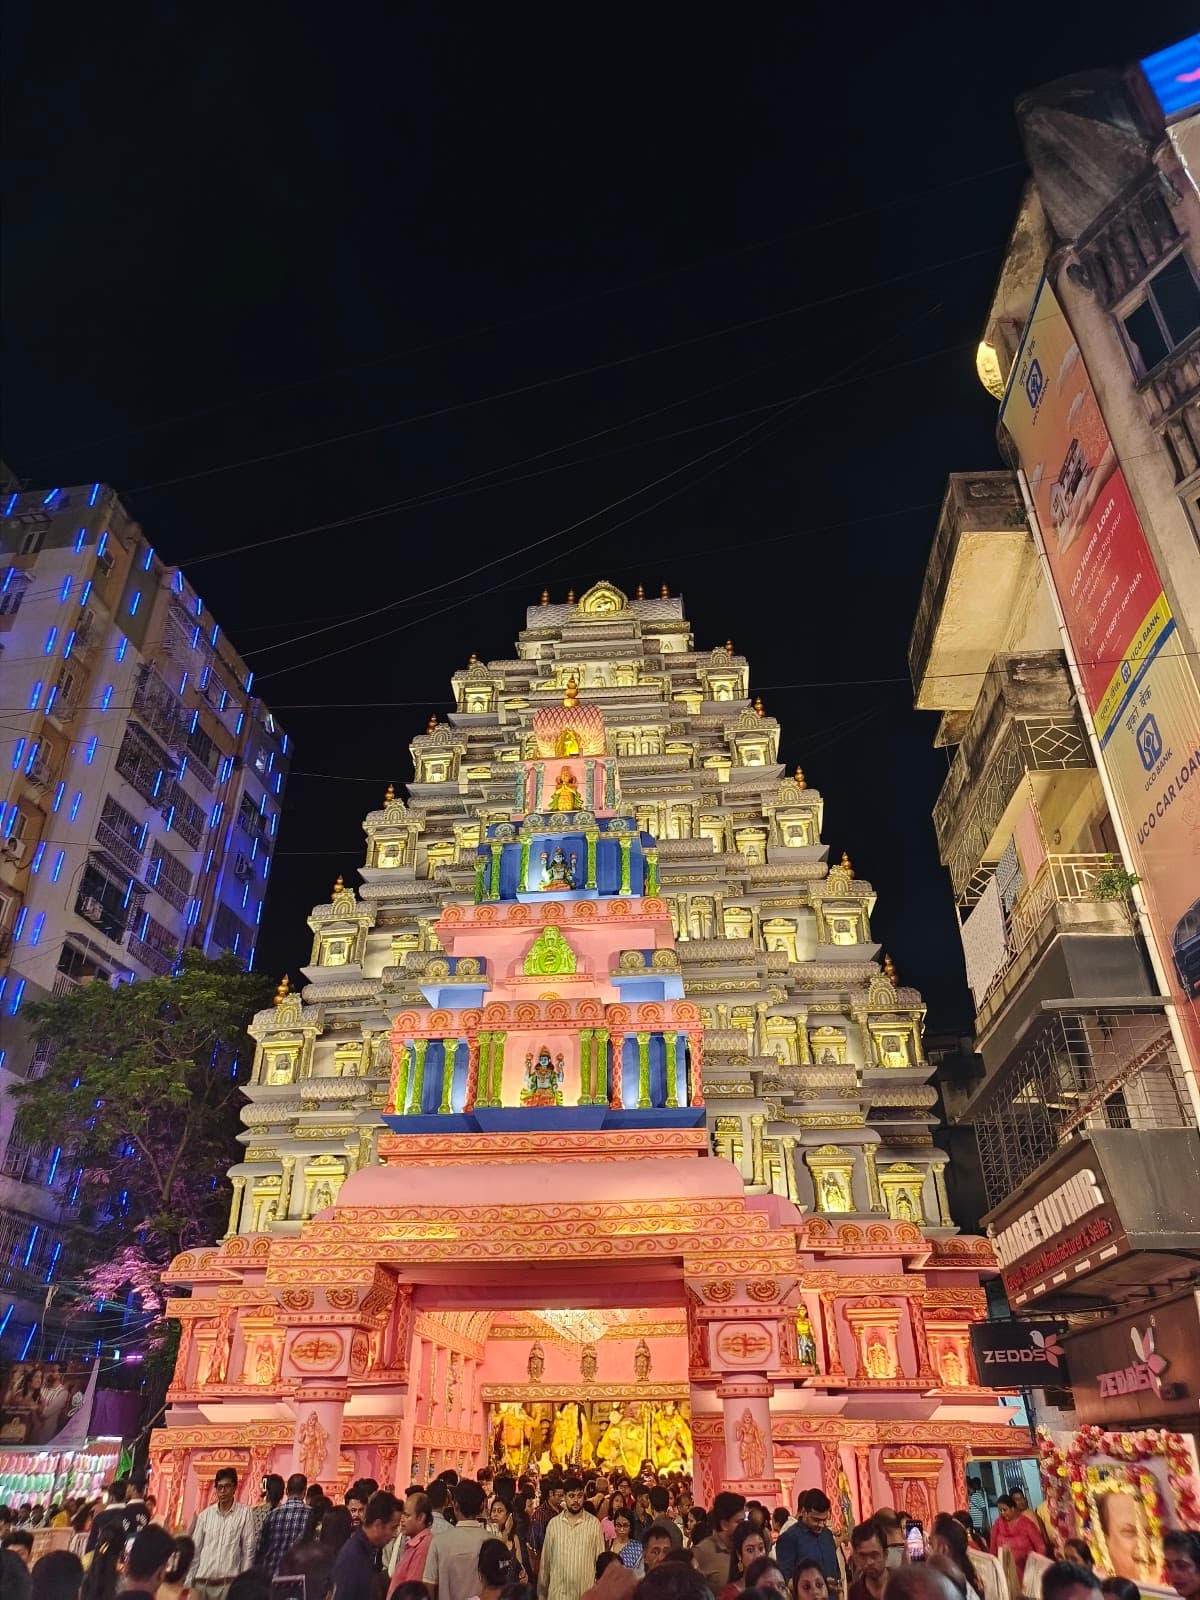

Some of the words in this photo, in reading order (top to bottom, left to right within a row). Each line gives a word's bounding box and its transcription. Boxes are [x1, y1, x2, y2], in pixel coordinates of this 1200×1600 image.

[1070, 568, 1082, 597] UCO
[1080, 532, 1098, 571] Home
[1096, 498, 1115, 533] Loan
[1121, 592, 1131, 613] per
[1129, 572, 1142, 594] lakh
[1130, 640, 1143, 661] UCO
[1142, 612, 1161, 642] BANK
[1144, 772, 1157, 792] UCO
[1155, 746, 1174, 776] BANK
[1137, 812, 1156, 845] UCO
[1156, 784, 1177, 818] CAR
[991, 1210, 1043, 1270] SHAREE
[1033, 1168, 1105, 1241] KUTHIR
